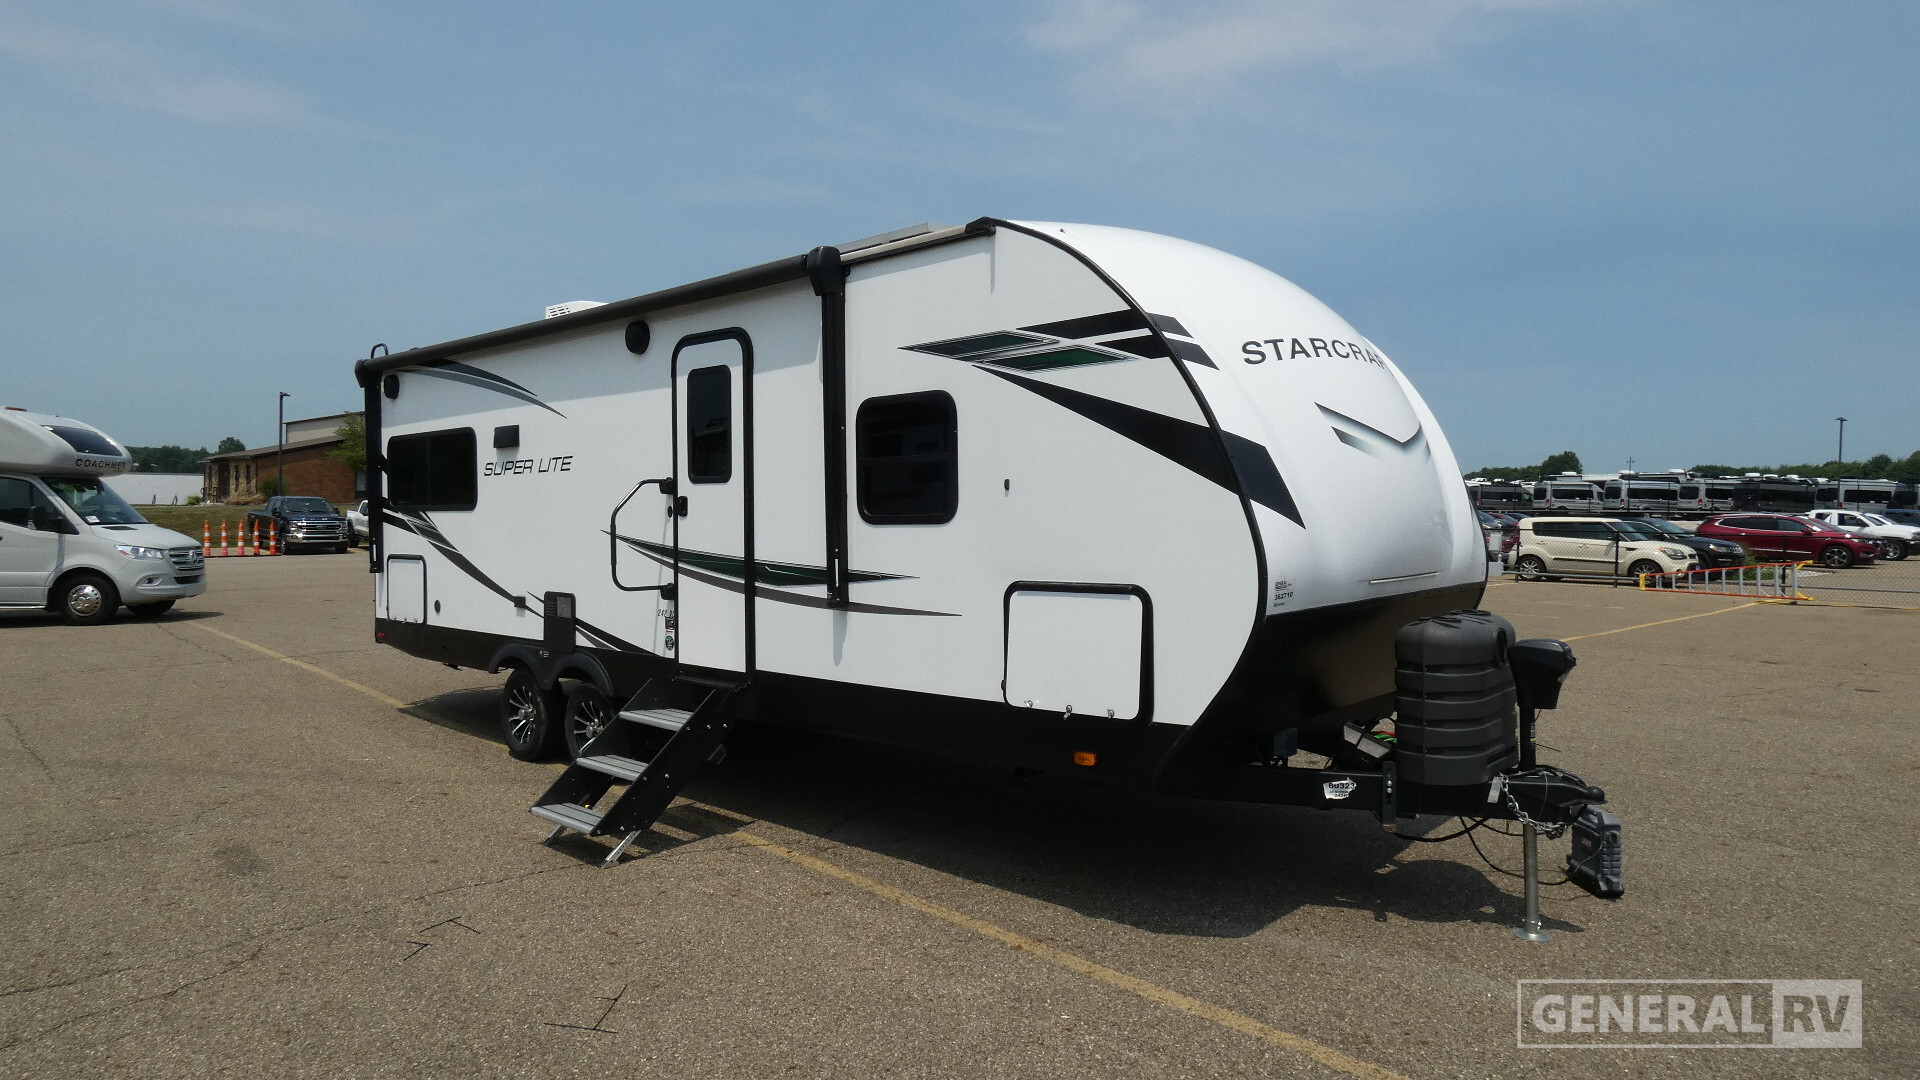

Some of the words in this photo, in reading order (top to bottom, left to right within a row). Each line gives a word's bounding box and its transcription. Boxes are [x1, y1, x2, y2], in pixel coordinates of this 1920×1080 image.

[1241, 337, 1386, 370] STARCRAF
[484, 459, 534, 476] SUPER
[538, 456, 573, 473] LITE
